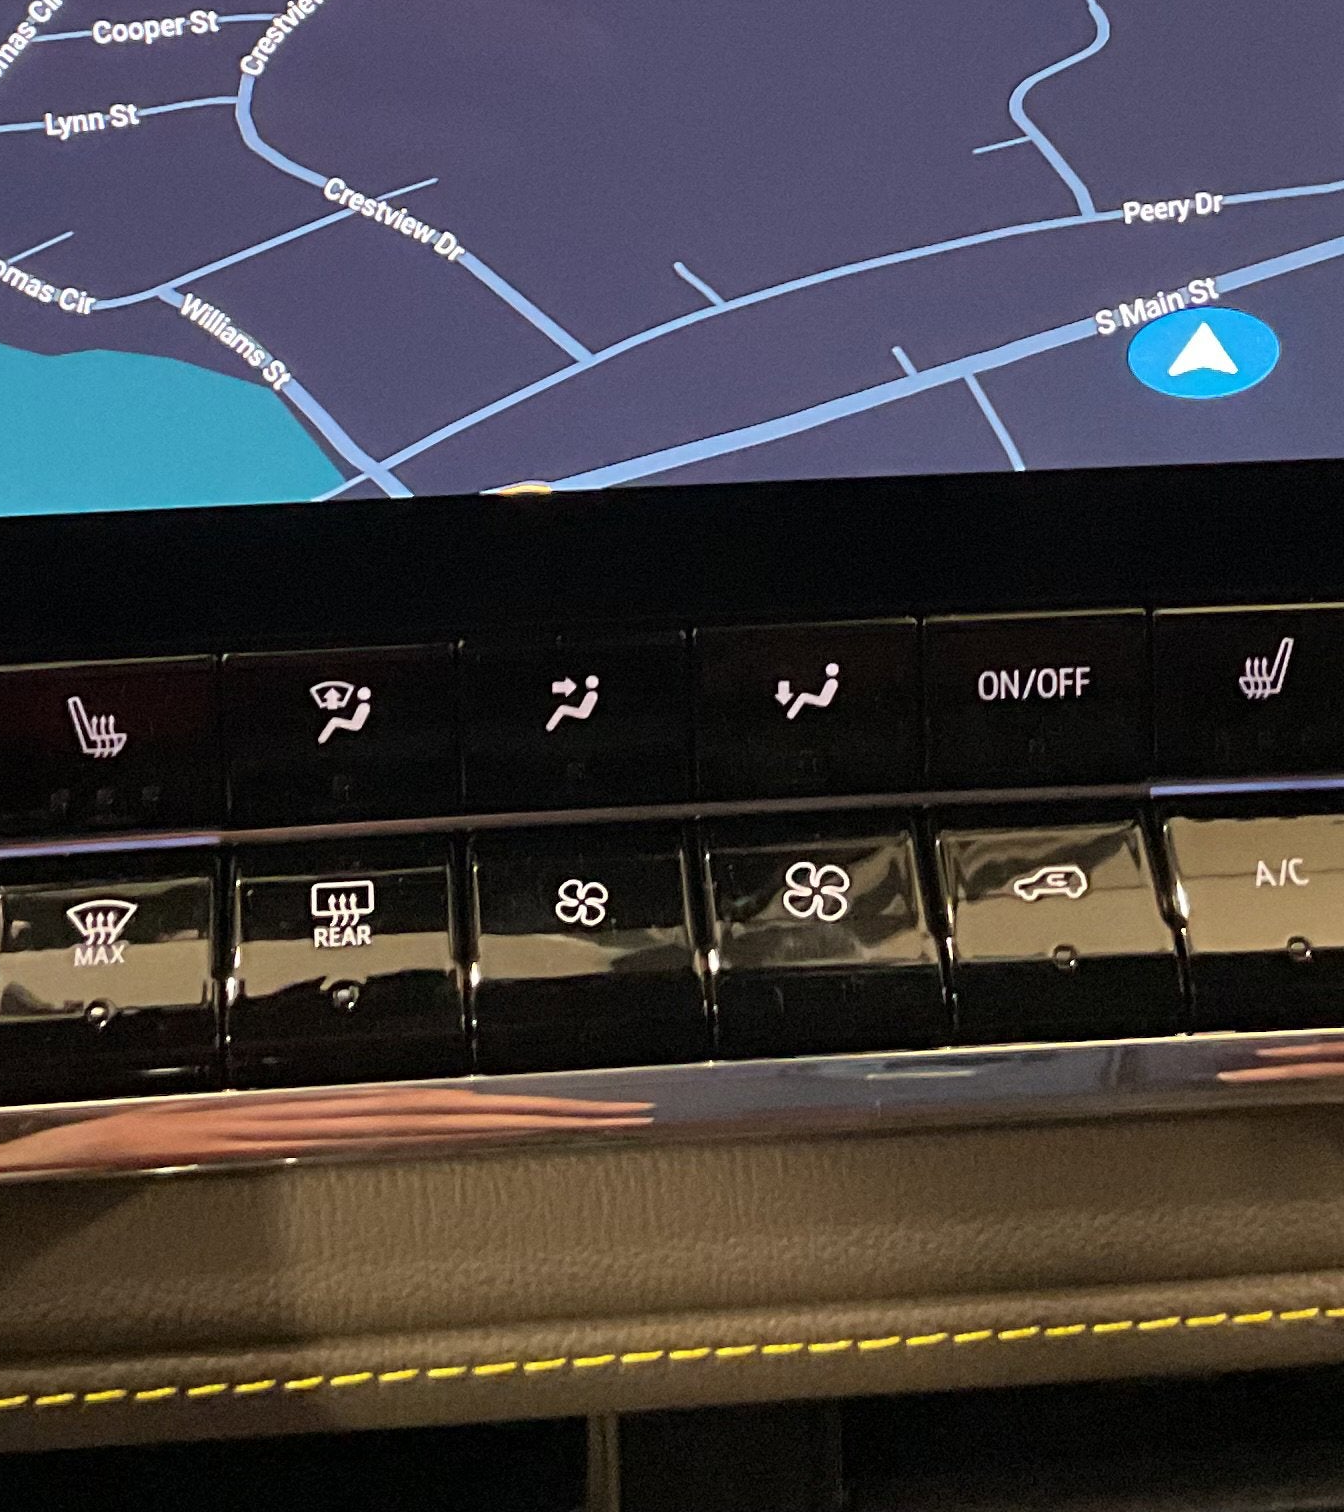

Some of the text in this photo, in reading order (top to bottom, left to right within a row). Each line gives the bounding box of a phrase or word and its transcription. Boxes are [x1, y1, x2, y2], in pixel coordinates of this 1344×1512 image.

[92, 10, 219, 45] Cooper St
[44, 103, 139, 141] Lynn St
[323, 176, 465, 262] Crestview Dr
[1123, 193, 1222, 225] Peery Dr
[58, 287, 96, 316] Cir
[1094, 276, 1220, 336] S Main St
[180, 293, 292, 390] Williams St
[977, 666, 1091, 702] ON/OFF
[1256, 857, 1309, 888] A/C
[313, 924, 372, 949] REAR
[74, 943, 126, 967] MAX
